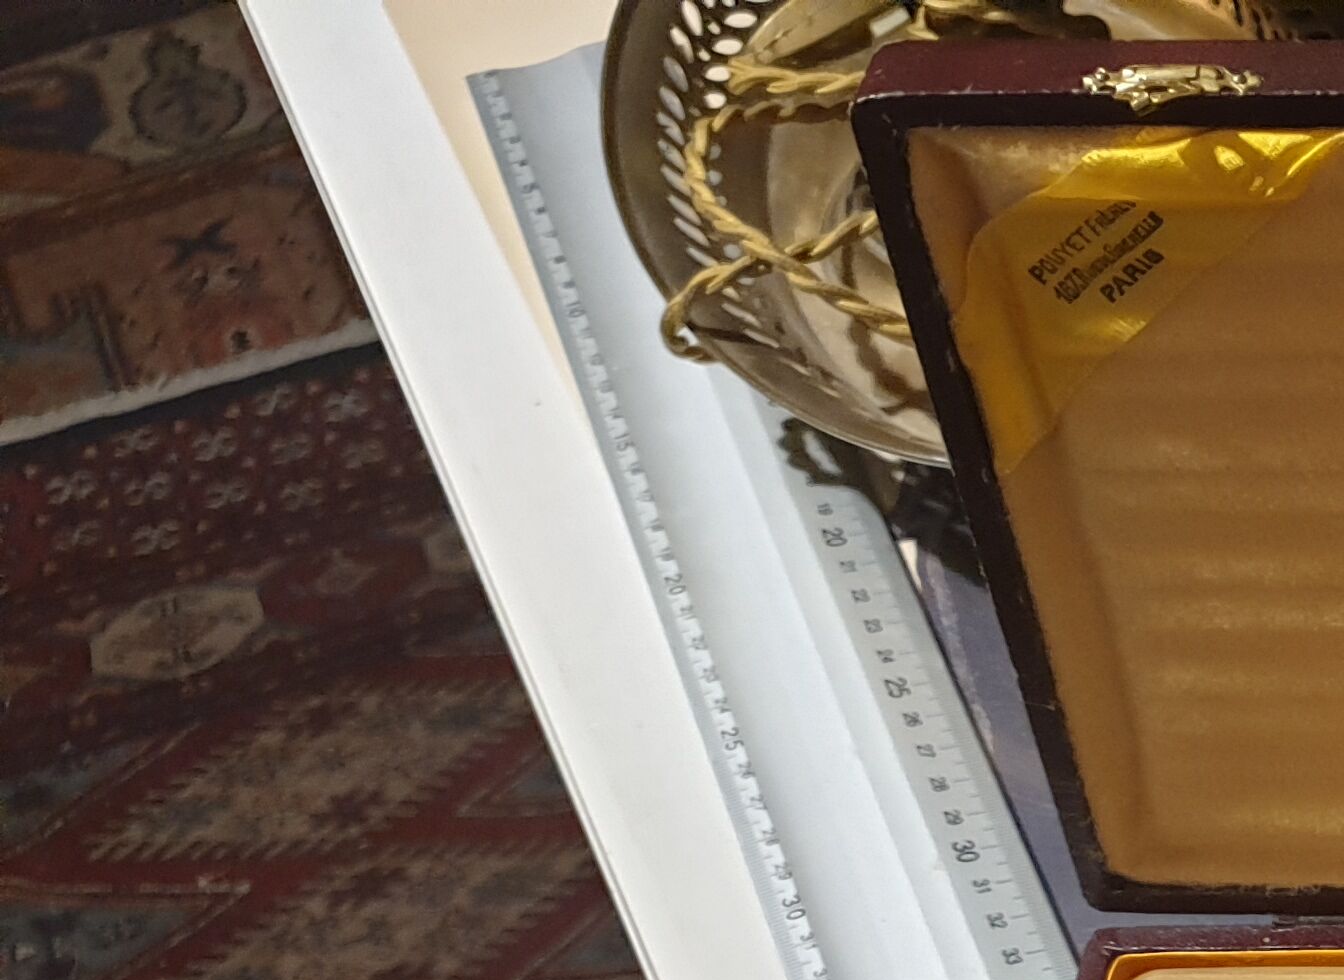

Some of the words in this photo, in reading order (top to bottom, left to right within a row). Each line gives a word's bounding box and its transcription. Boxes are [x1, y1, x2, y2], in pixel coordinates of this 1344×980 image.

[1028, 226, 1092, 286] POUYET
[663, 573, 687, 595] 20
[721, 727, 744, 751] 25
[782, 895, 806, 920] 30
[821, 527, 848, 548] 20
[884, 677, 911, 698] 25
[916, 743, 936, 758] 27
[952, 839, 980, 863] 30
[972, 877, 992, 894] 31
[986, 912, 1008, 929] 32
[1002, 948, 1023, 965] 33
